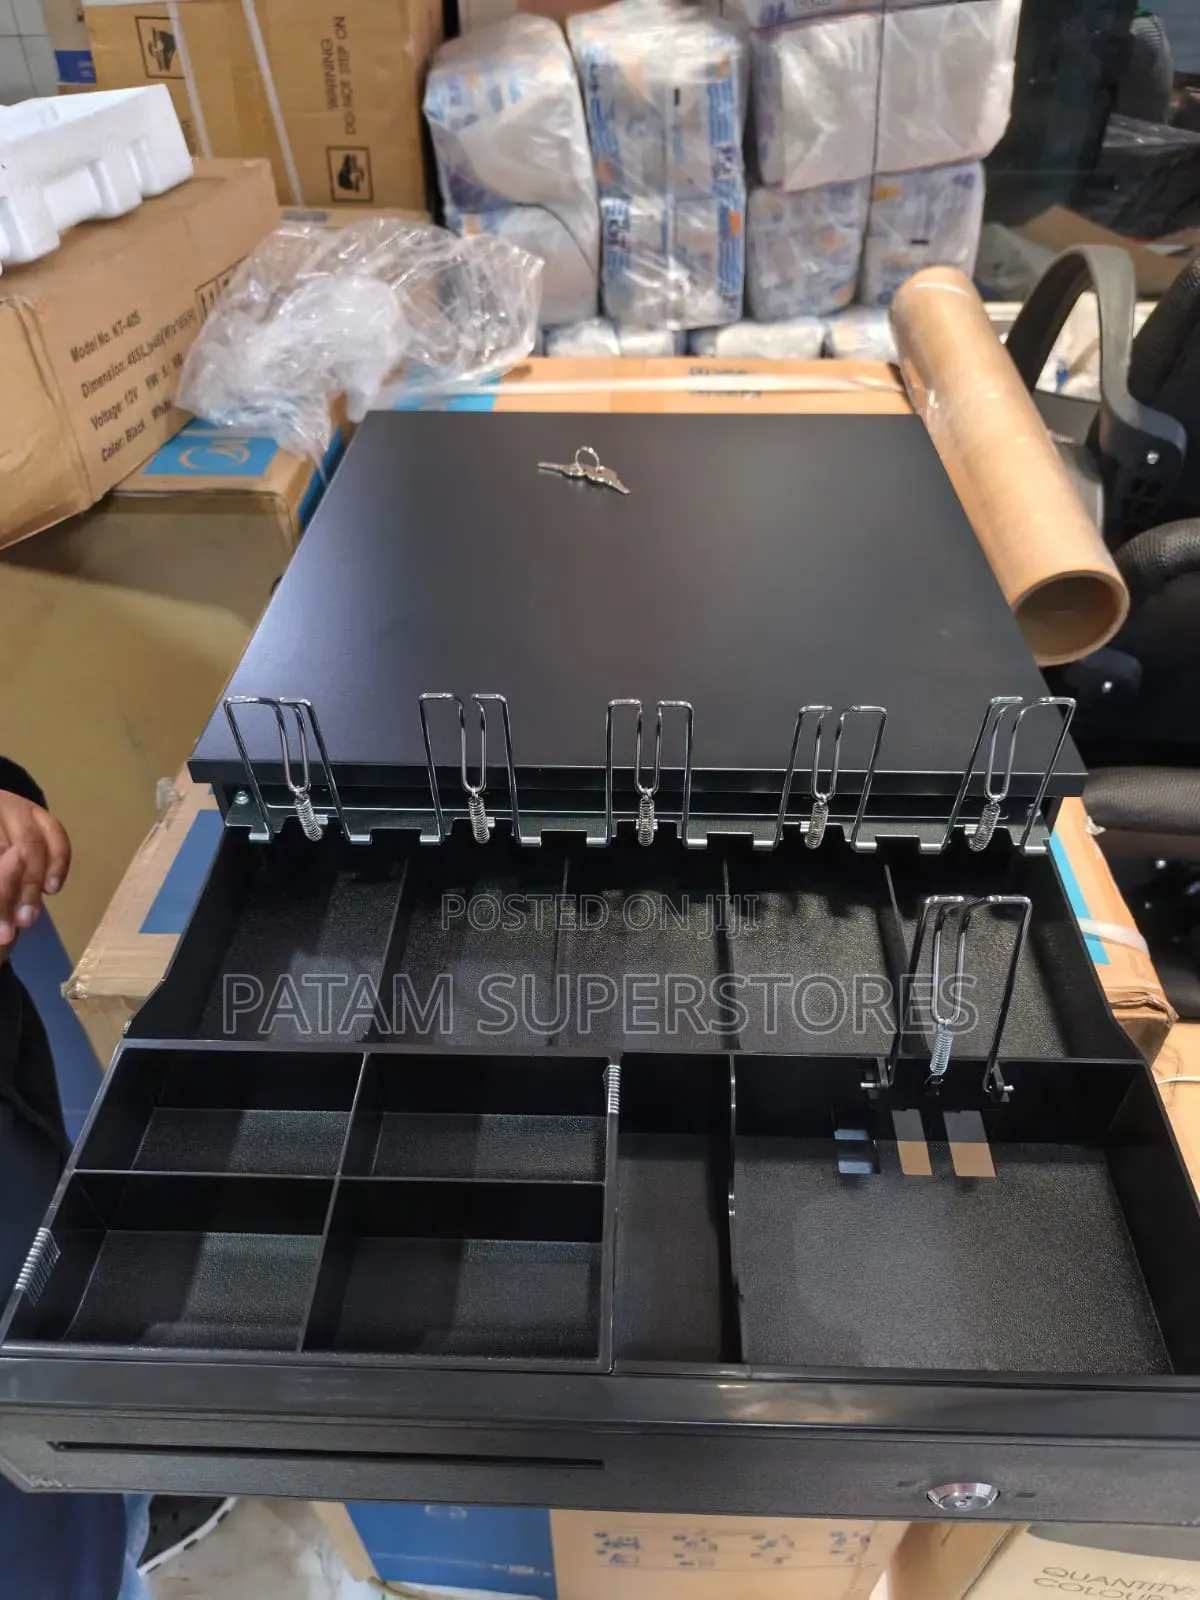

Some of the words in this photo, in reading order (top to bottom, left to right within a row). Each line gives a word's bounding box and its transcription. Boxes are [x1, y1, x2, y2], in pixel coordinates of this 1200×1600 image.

[333, 16, 347, 40] ON
[337, 45, 352, 75] STEP
[320, 38, 339, 111] WARNING
[341, 80, 354, 108] NOT
[344, 111, 357, 135] DO
[125, 420, 146, 443] Black
